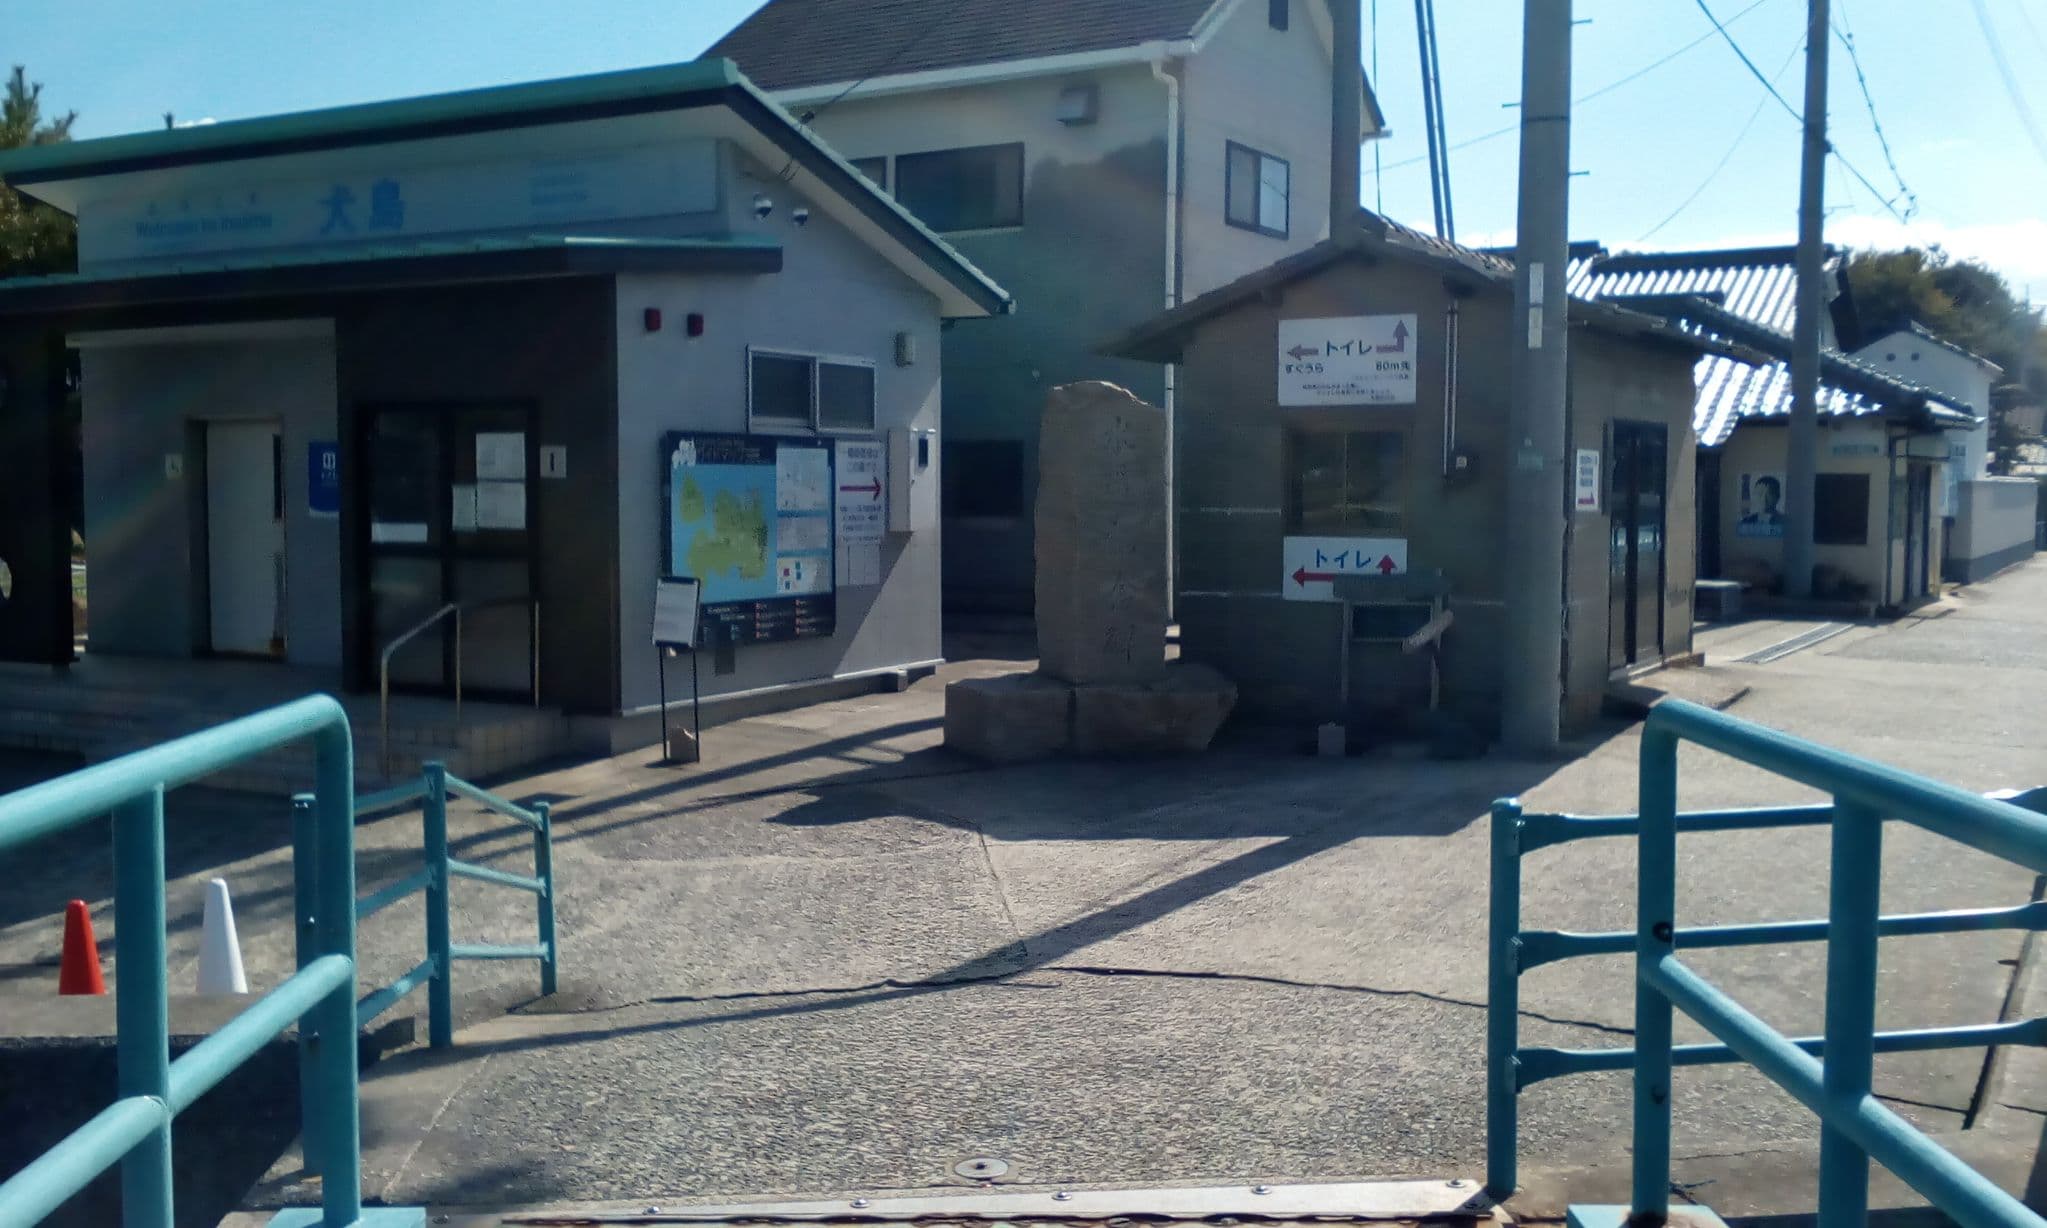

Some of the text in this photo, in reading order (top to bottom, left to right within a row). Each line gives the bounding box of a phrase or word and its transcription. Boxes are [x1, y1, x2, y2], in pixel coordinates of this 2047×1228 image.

[1326, 339, 1373, 357] トイレ
[1285, 362, 1324, 374] すぐうら
[1316, 548, 1372, 568] トイレ
